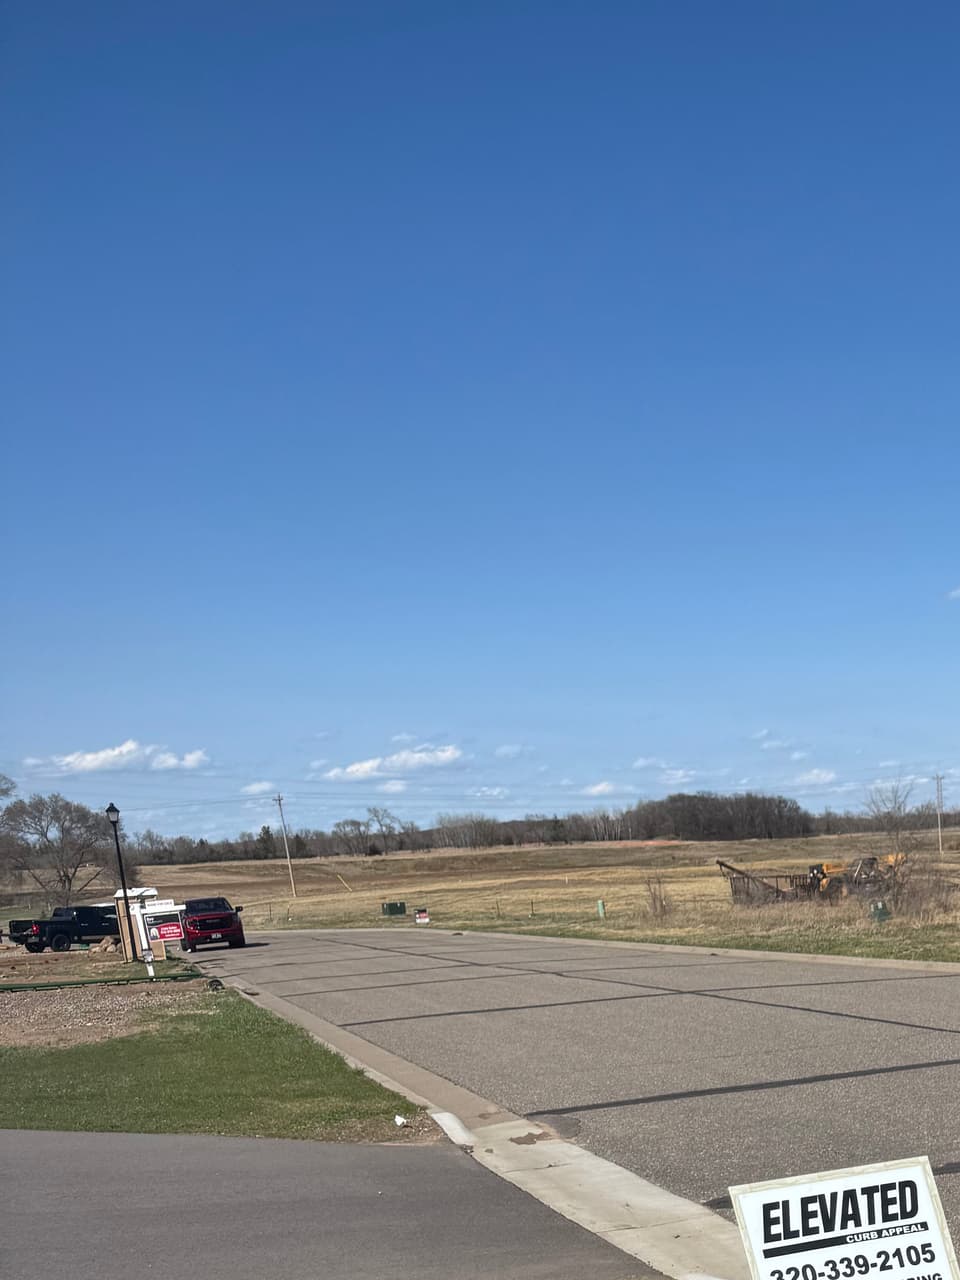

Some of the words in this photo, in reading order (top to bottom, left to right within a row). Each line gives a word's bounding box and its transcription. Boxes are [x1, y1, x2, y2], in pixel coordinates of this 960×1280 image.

[762, 1180, 919, 1244] ELEVATED
[845, 1230, 878, 1243] CURB
[881, 1223, 925, 1239] APPEAL
